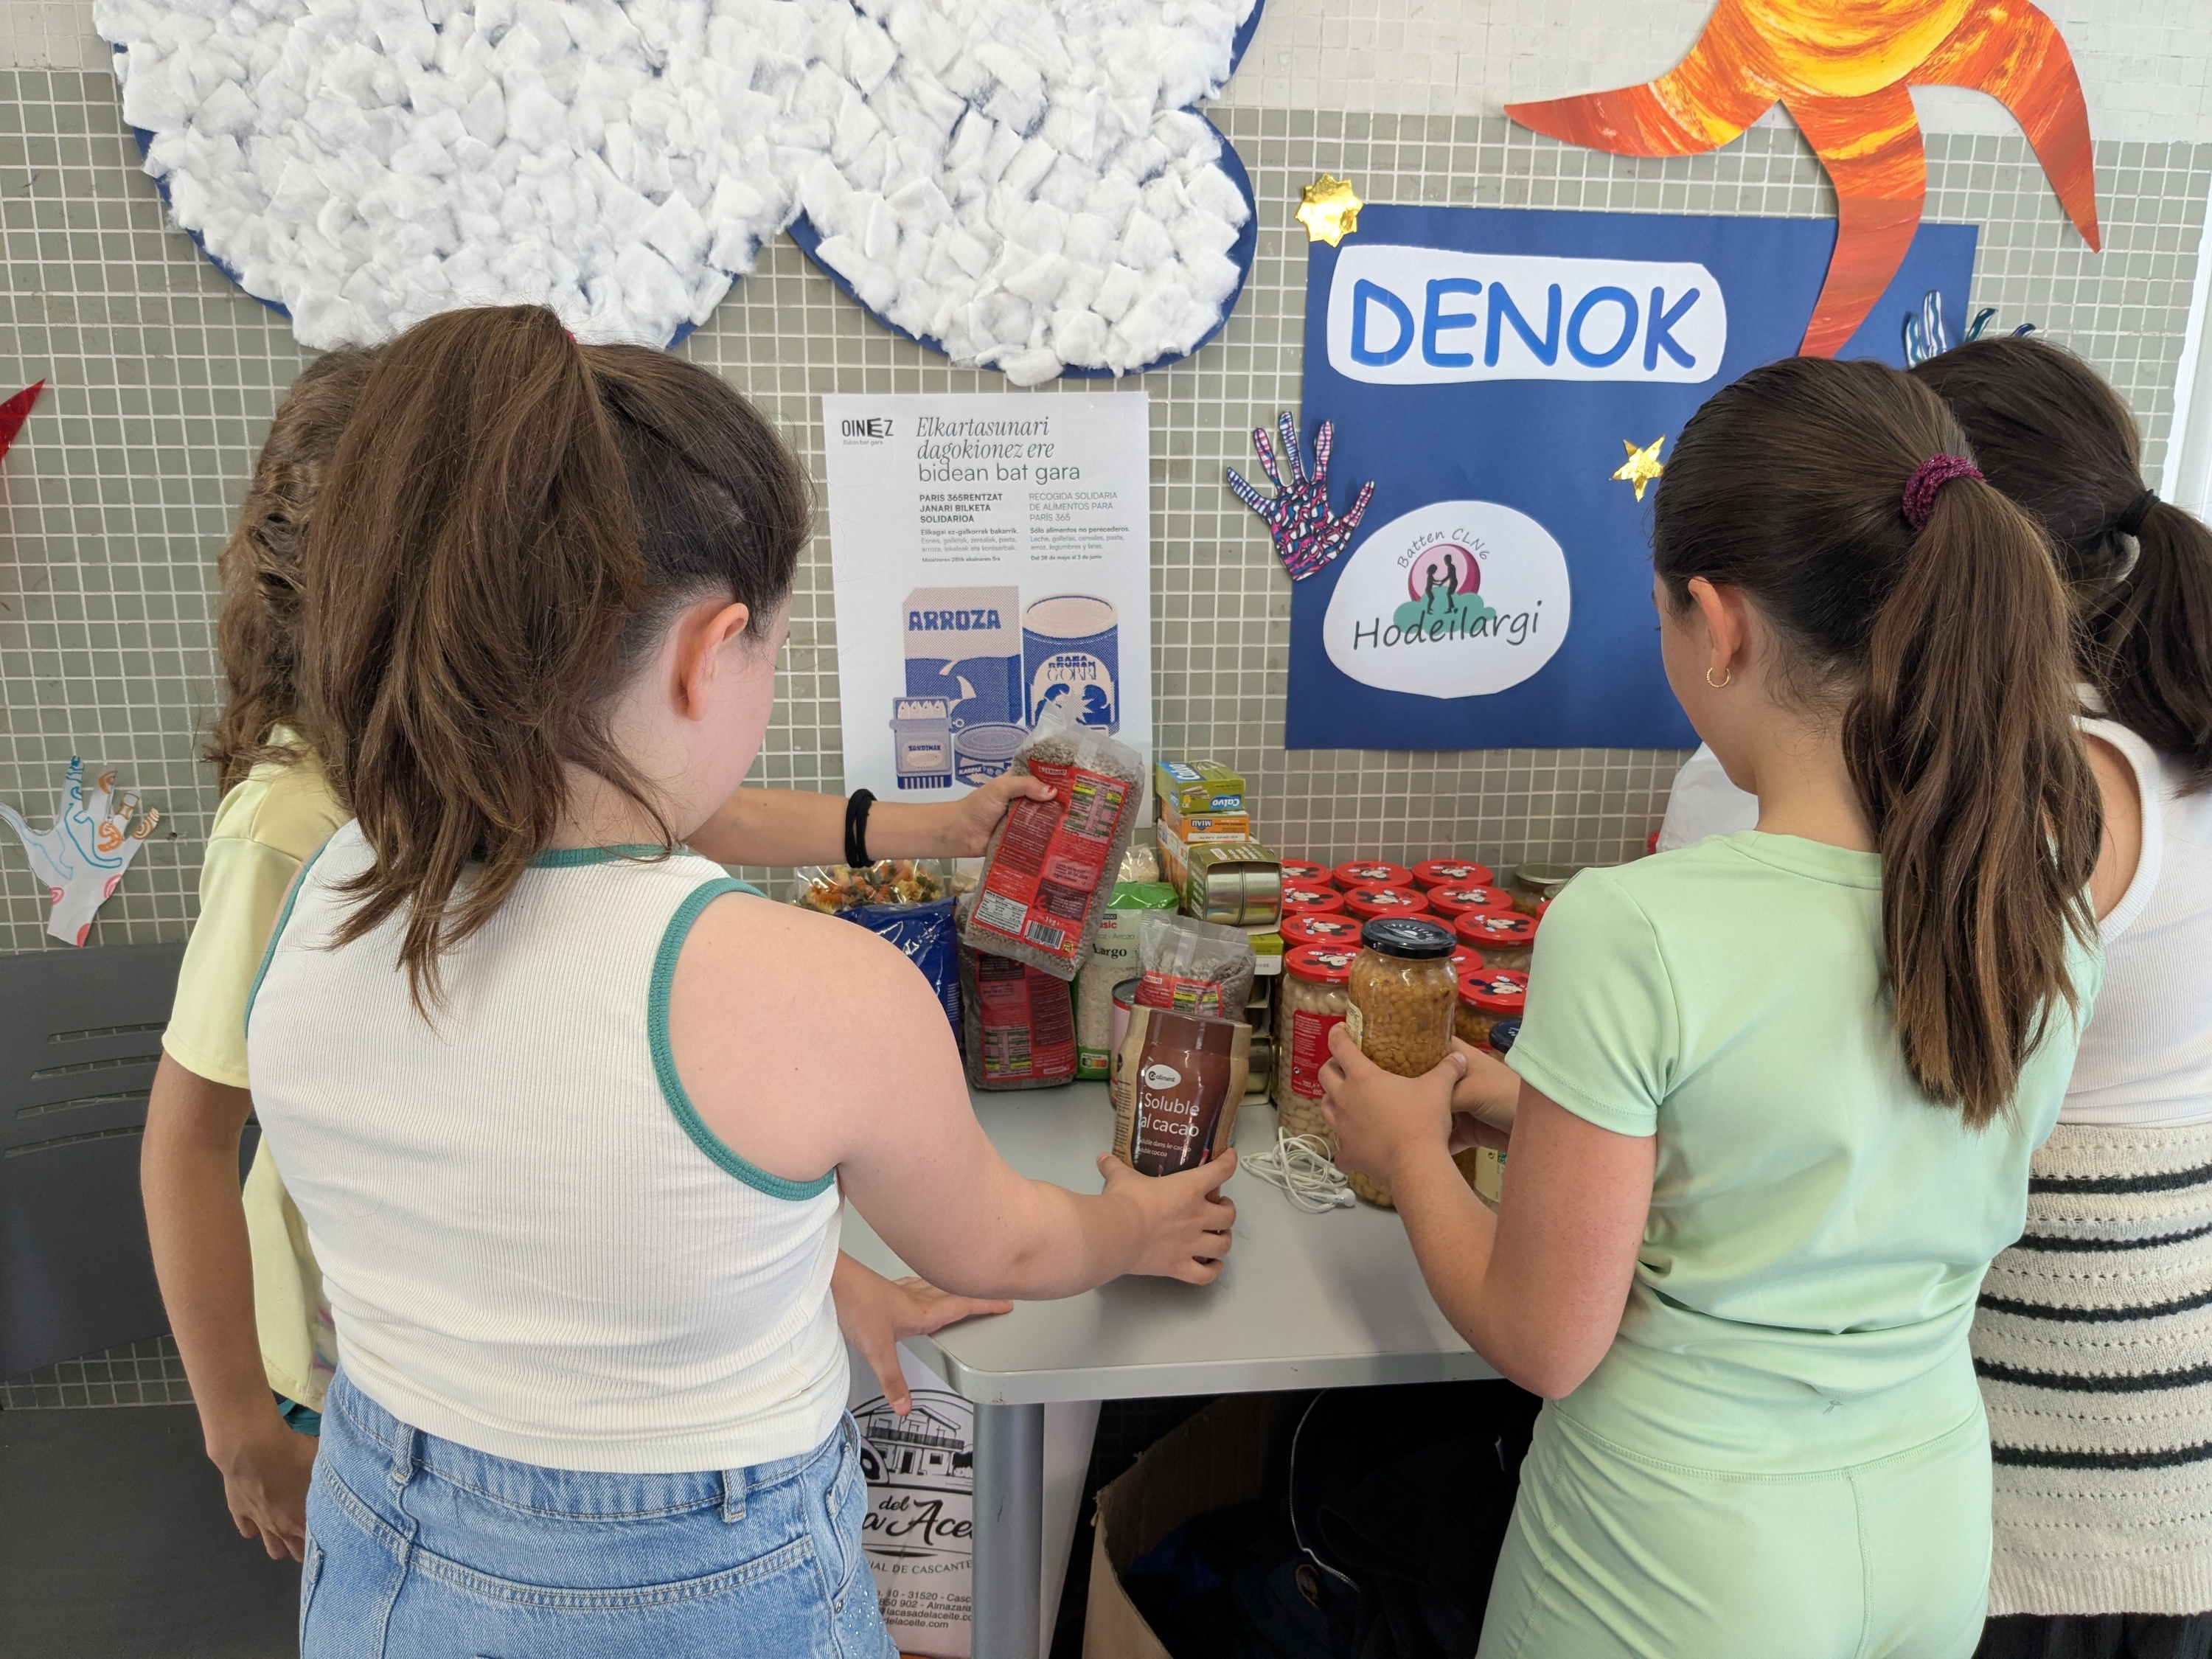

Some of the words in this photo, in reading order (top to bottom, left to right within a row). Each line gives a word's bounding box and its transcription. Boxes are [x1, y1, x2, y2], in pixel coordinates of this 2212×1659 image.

[1350, 278, 1700, 371] DENOK
[842, 418, 894, 439] OINEZ
[916, 416, 1050, 437] Elkartasunari
[917, 439, 1023, 465] dagokionez
[1027, 443, 1055, 459] ere
[919, 463, 989, 482] bidean
[996, 463, 1028, 481] bat
[1035, 465, 1080, 485] gara
[947, 493, 1003, 501] 365RENTZAT
[1029, 493, 1073, 501] RECOGIDA
[1074, 492, 1118, 500] SOLIDARIA
[919, 504, 953, 512] JANARI
[920, 515, 975, 523] SOLIDARIOA
[1054, 513, 1071, 521] 365
[921, 529, 946, 537] Elikagai
[947, 528, 989, 536] ez-galkorrak
[1397, 531, 1445, 568] Batten
[1452, 528, 1490, 560] CLN6
[909, 609, 1001, 631] ARROZA
[1352, 599, 1543, 650] Hodeilargi
[1211, 798, 1240, 807] Calvo
[1100, 921, 1118, 929] asic
[1093, 943, 1127, 959] Largo
[1144, 1093, 1200, 1116] Soluble
[1141, 1113, 1152, 1128] al
[1152, 1119, 1200, 1137] cacao
[1153, 1140, 1166, 1148] dans
[879, 1495, 911, 1511] del
[886, 1499, 973, 1545] Ace
[869, 1560, 887, 1572] IAL
[892, 1564, 908, 1573] DE
[912, 1560, 972, 1574] CASCANTE
[887, 1590, 899, 1598] 10
[908, 1591, 938, 1600] 31520
[947, 1593, 972, 1602] Casc
[900, 1599, 917, 1608] 902
[927, 1601, 972, 1612] Almazara
[883, 1617, 949, 1629] delaceite.com
